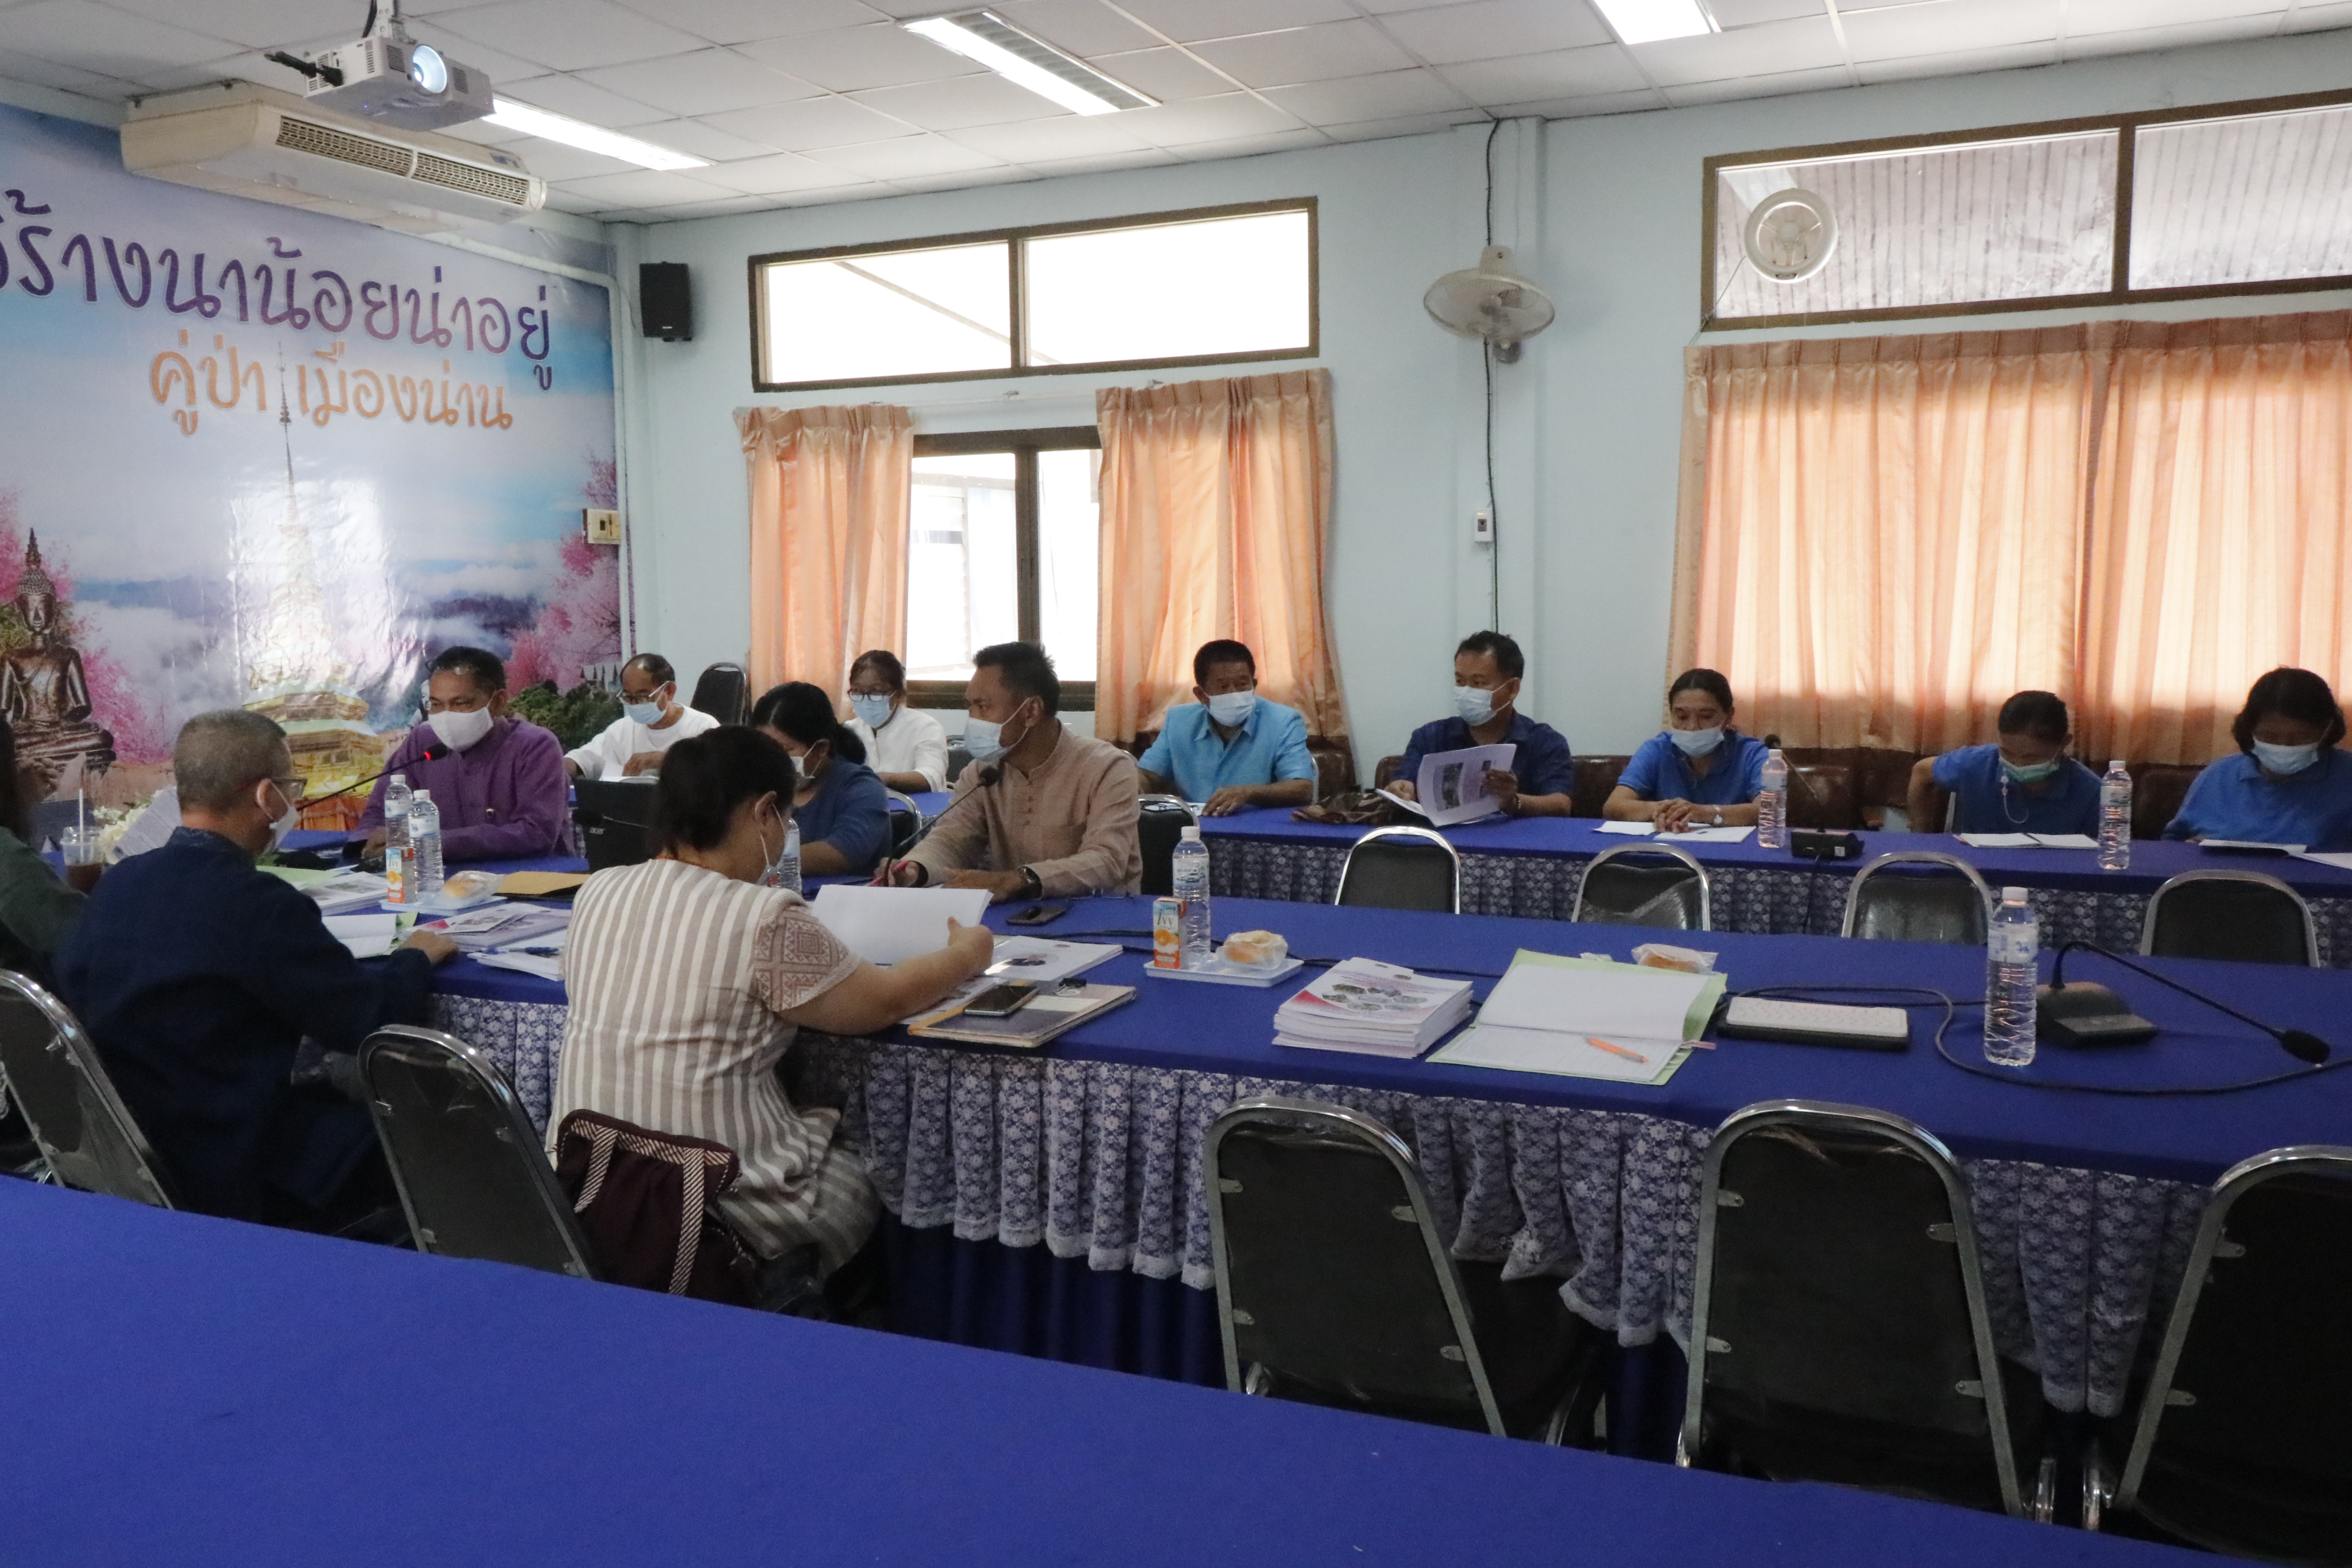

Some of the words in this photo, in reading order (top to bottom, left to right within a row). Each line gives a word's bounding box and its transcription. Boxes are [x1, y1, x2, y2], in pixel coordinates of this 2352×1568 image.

[0, 188, 551, 390] ร้างนาน้อยน่าอยู่
[151, 329, 267, 436] คู่ป่า
[298, 340, 513, 430] เมืองน่าน
